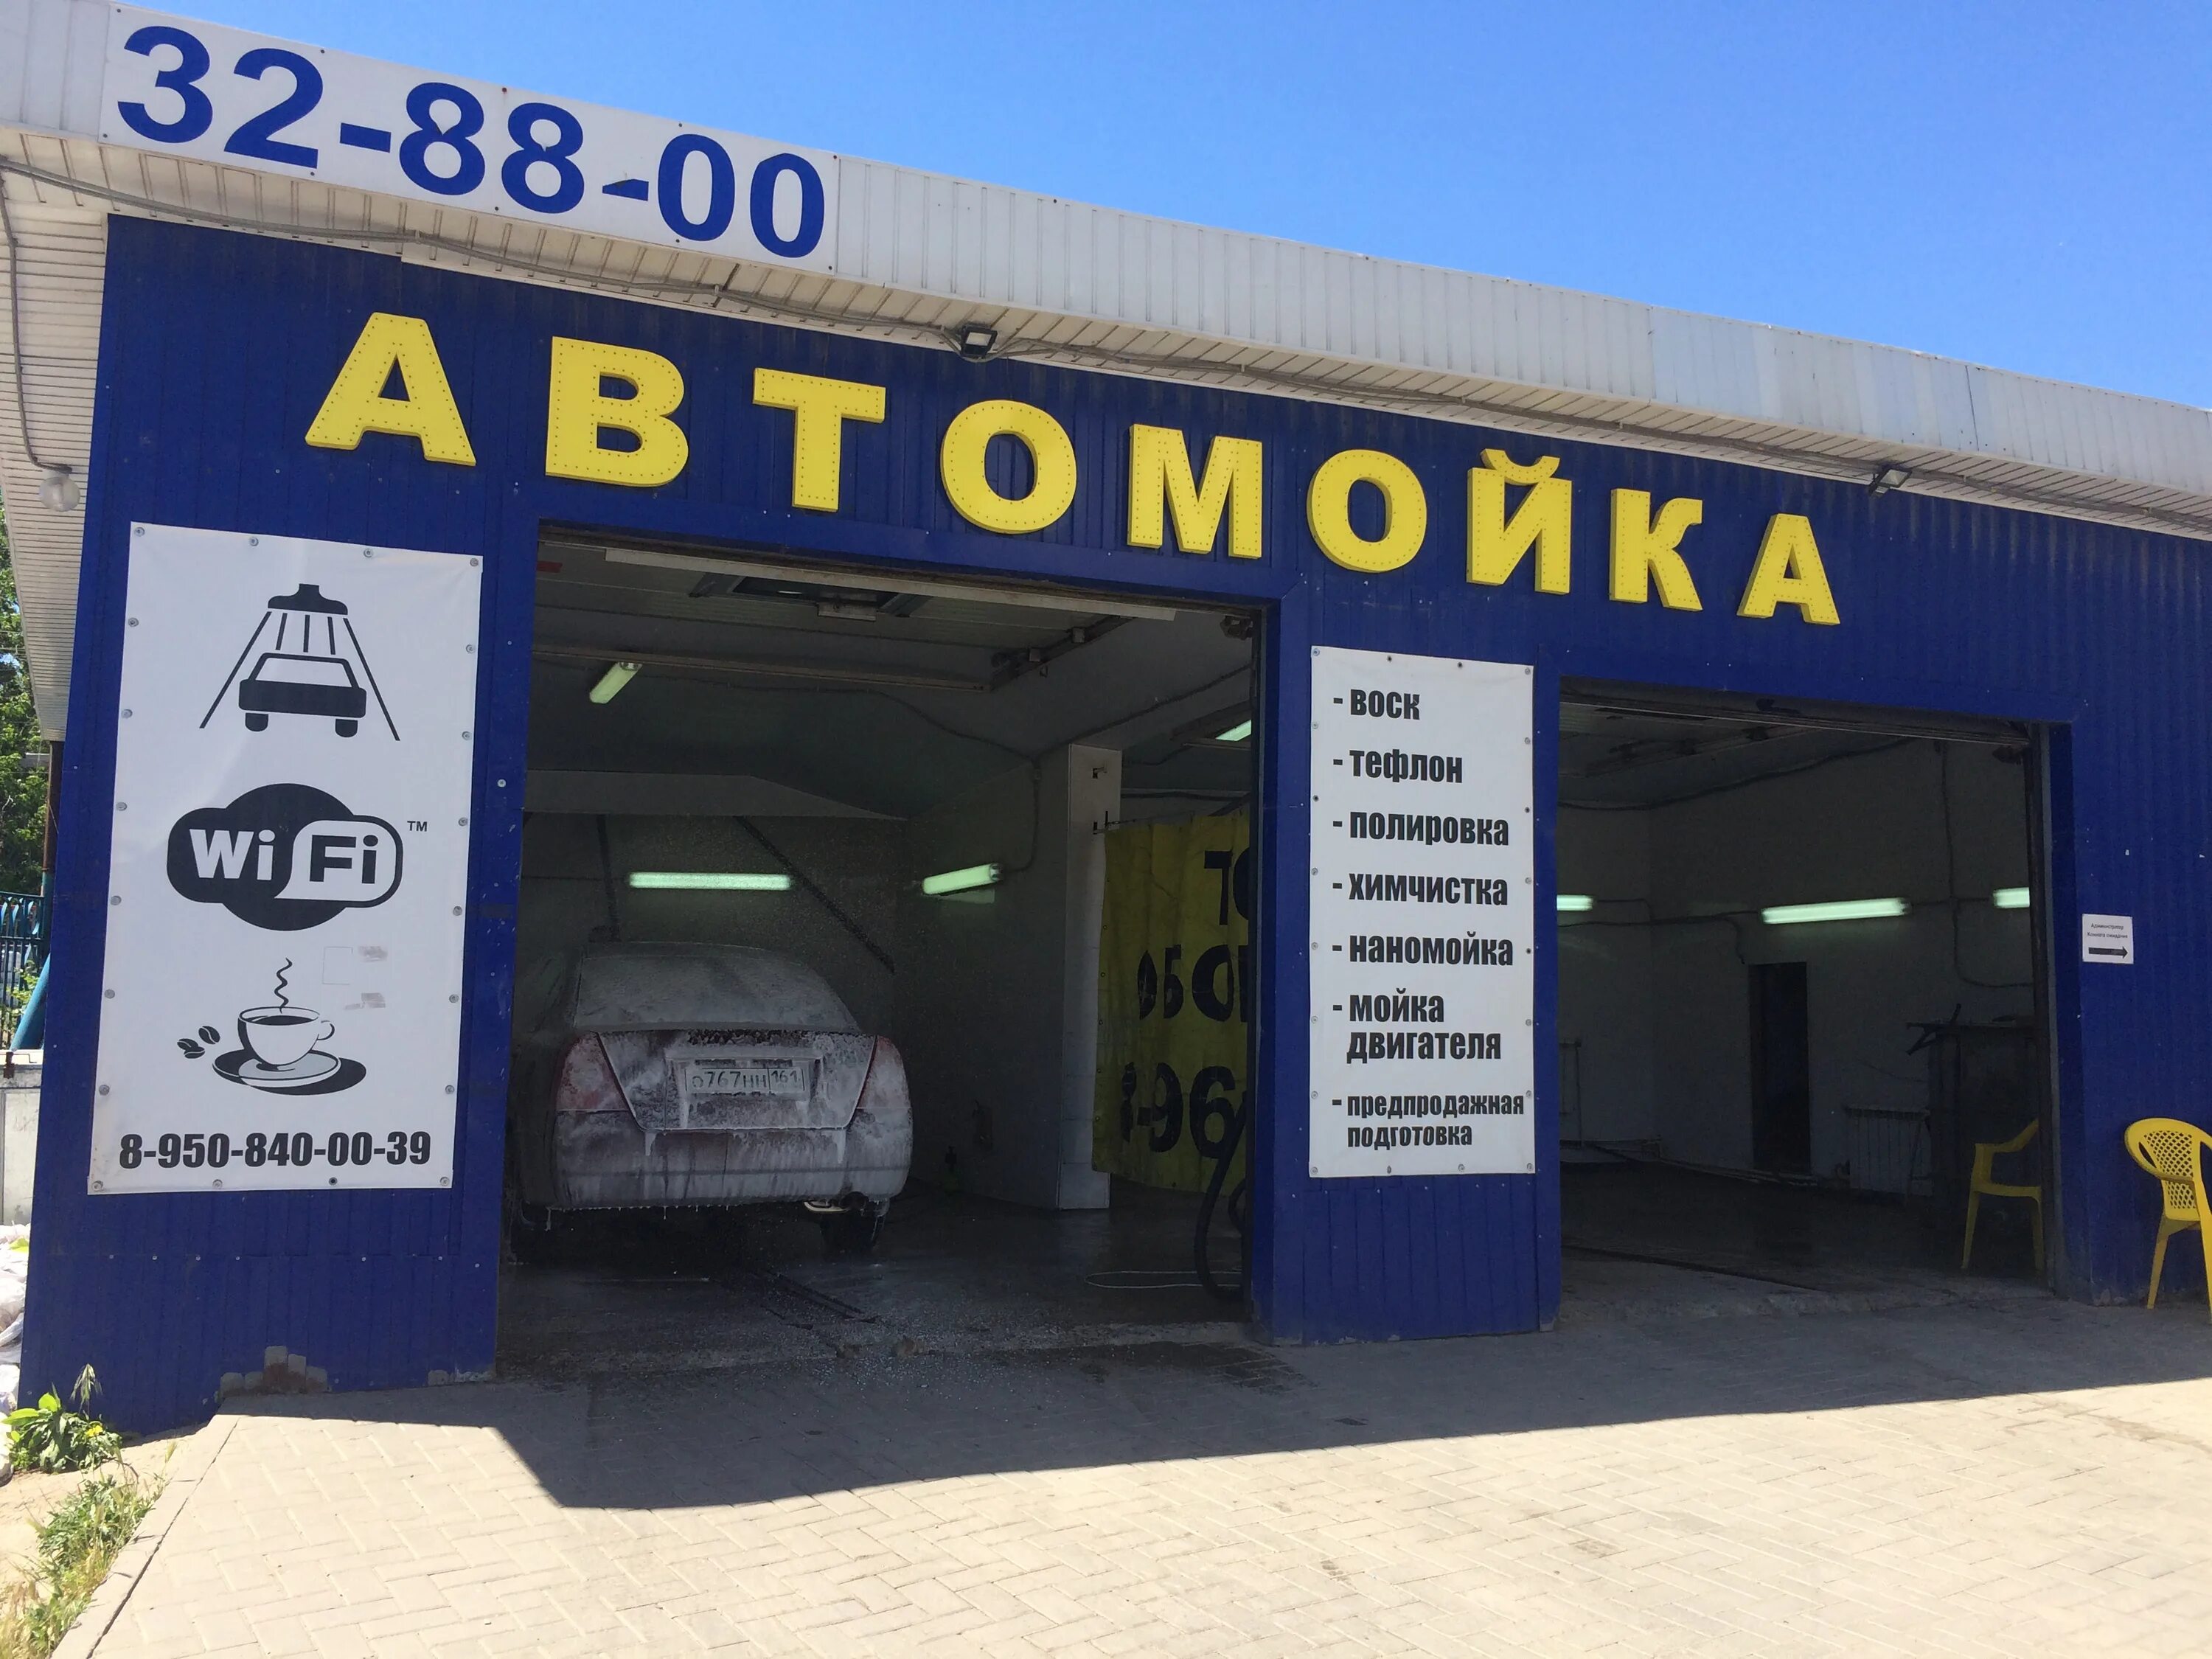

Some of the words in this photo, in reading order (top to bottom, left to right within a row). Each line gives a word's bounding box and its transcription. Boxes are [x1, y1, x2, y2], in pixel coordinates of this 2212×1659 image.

[118, 25, 824, 258] 32-88-00
[305, 311, 1840, 625] АВТОМОЙКА
[1349, 748, 1463, 784] тефлон
[407, 820, 428, 832] TM
[1350, 811, 1509, 846] полировка
[1349, 873, 1508, 906] химчистка
[1349, 931, 1513, 966] наномойка
[1349, 987, 1444, 1023] мойка
[1346, 1032, 1501, 1065] двигателя
[1347, 1095, 1524, 1120] предпродажная
[119, 1131, 431, 1169] 8-950-840-00-39
[1347, 1125, 1472, 1151] подготовка
